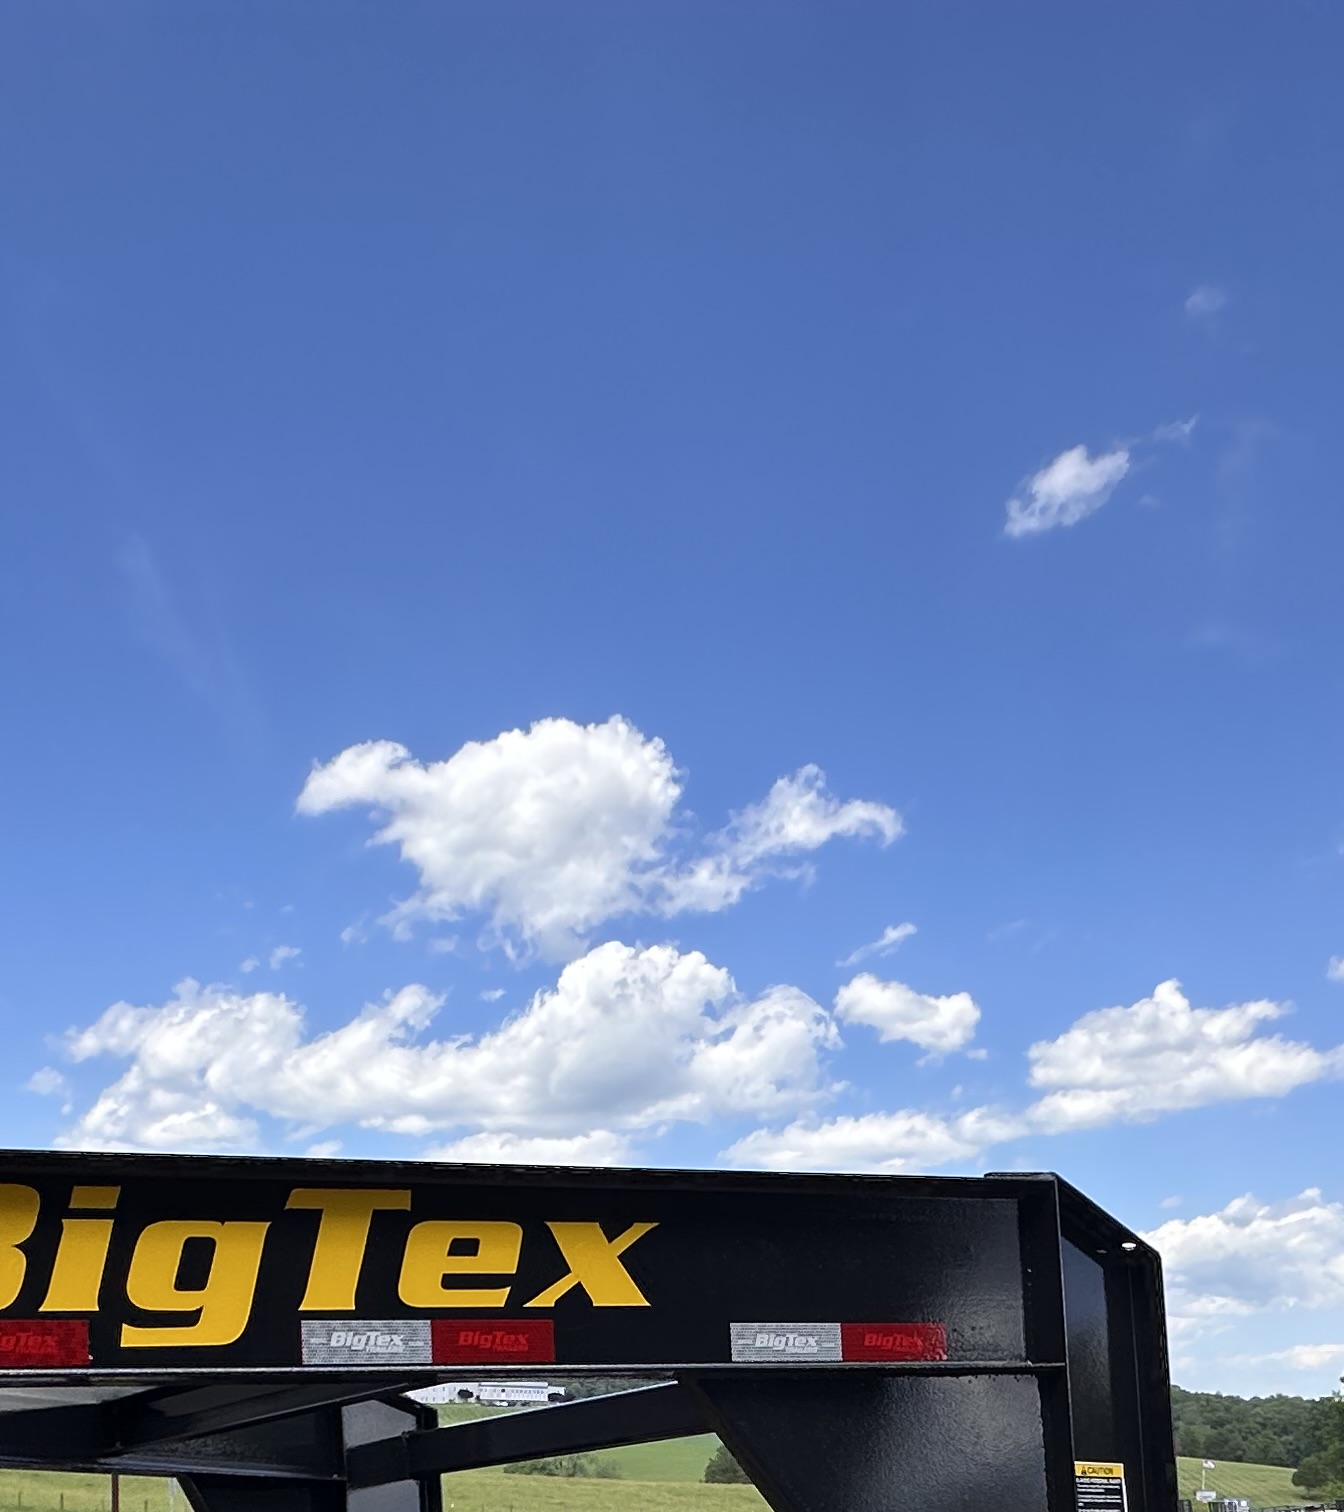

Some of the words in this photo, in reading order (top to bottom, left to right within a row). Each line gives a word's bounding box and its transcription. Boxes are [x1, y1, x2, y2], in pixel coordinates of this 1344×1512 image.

[330, 1331, 405, 1350] BigTex
[458, 1331, 529, 1350] BigTex
[754, 1332, 820, 1351] BigTex
